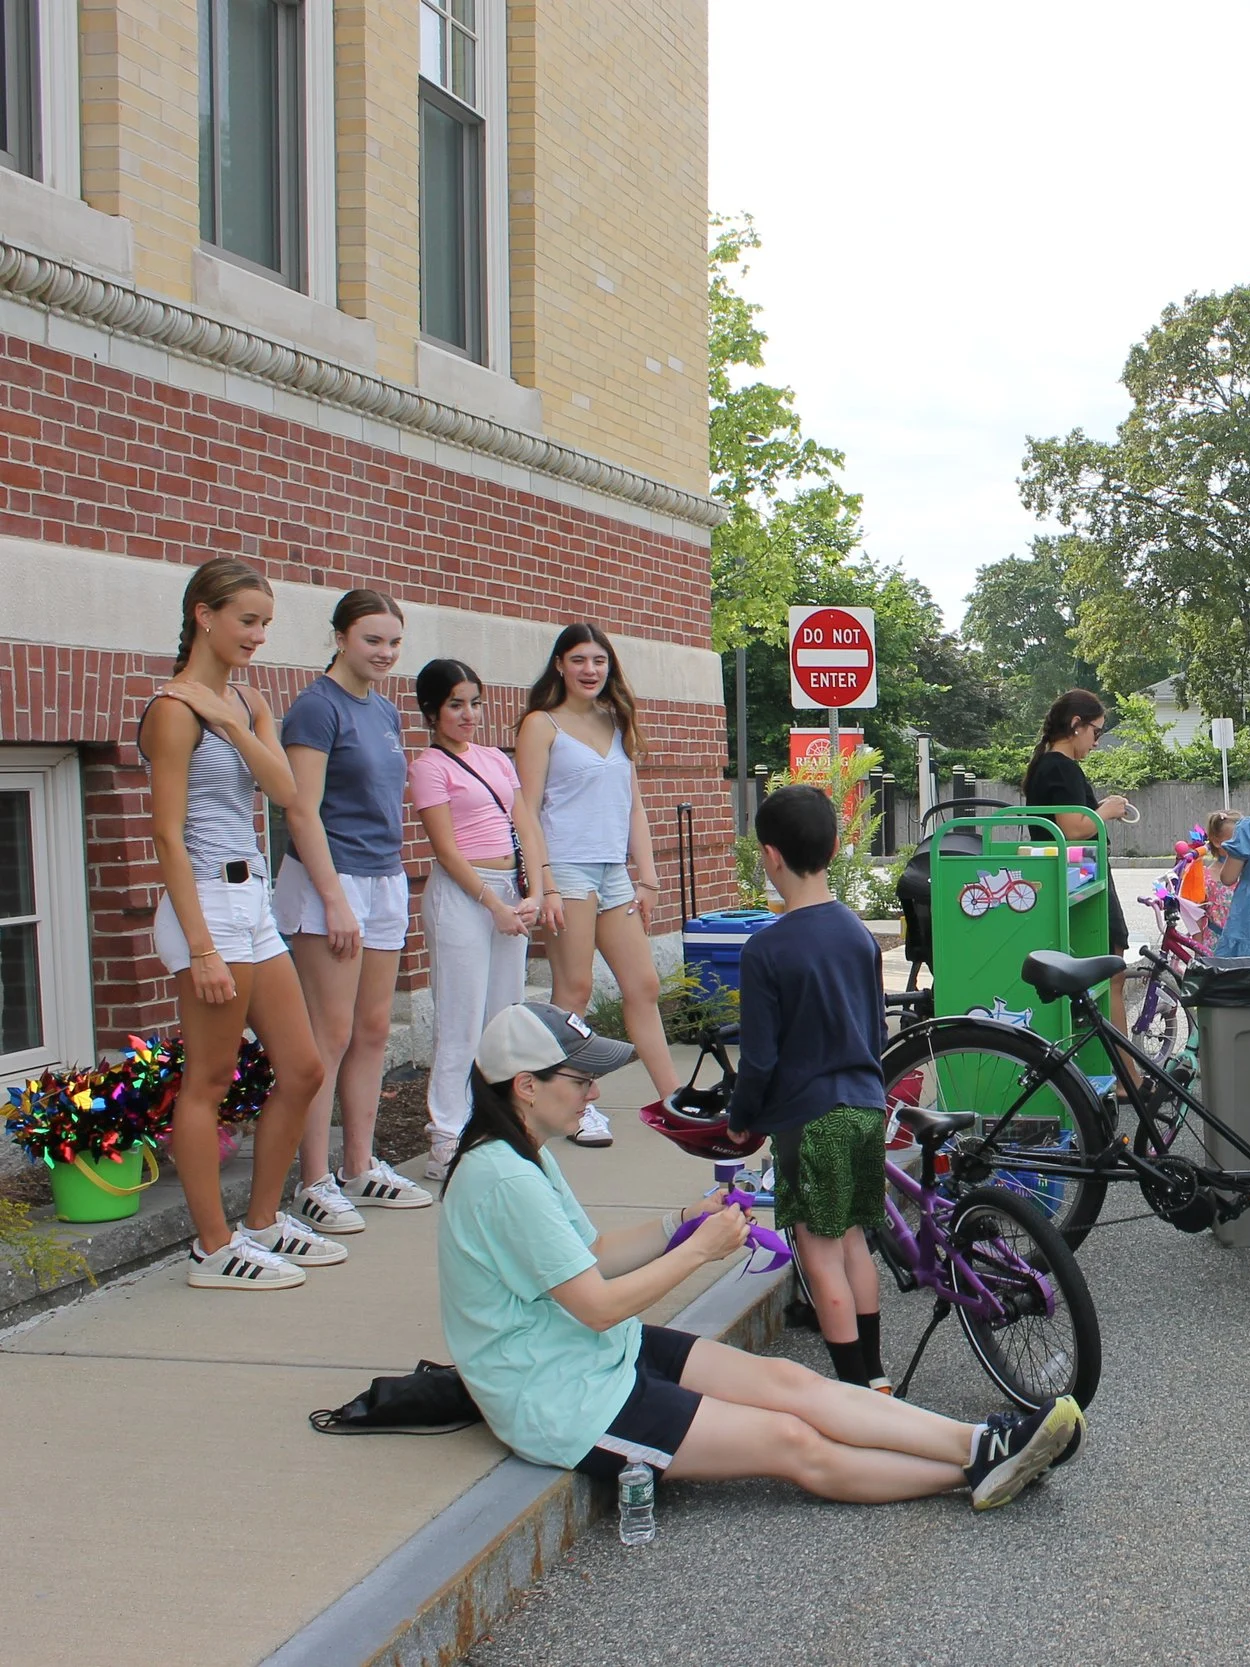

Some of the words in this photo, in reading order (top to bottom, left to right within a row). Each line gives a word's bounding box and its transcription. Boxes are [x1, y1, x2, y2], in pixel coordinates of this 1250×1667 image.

[803, 627, 824, 644] DO
[832, 628, 861, 644] NOT
[810, 672, 857, 688] ENTER
[795, 756, 849, 767] READIG
